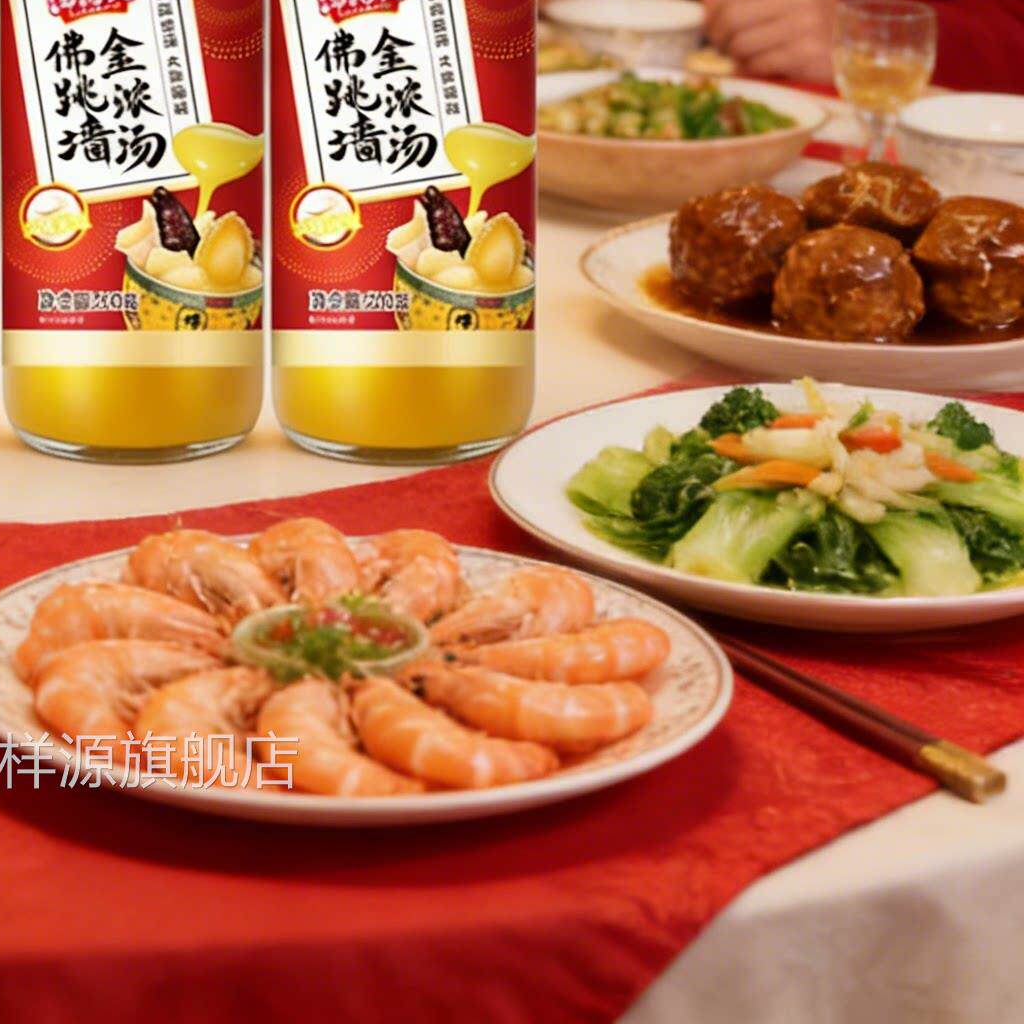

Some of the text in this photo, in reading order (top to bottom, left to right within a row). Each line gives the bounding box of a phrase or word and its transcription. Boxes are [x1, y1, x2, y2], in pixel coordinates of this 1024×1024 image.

[44, 28, 116, 172] 佛跳墙
[100, 27, 167, 173] 金浓汤
[315, 28, 387, 172] 佛跳墙
[371, 27, 438, 173] 金浓汤
